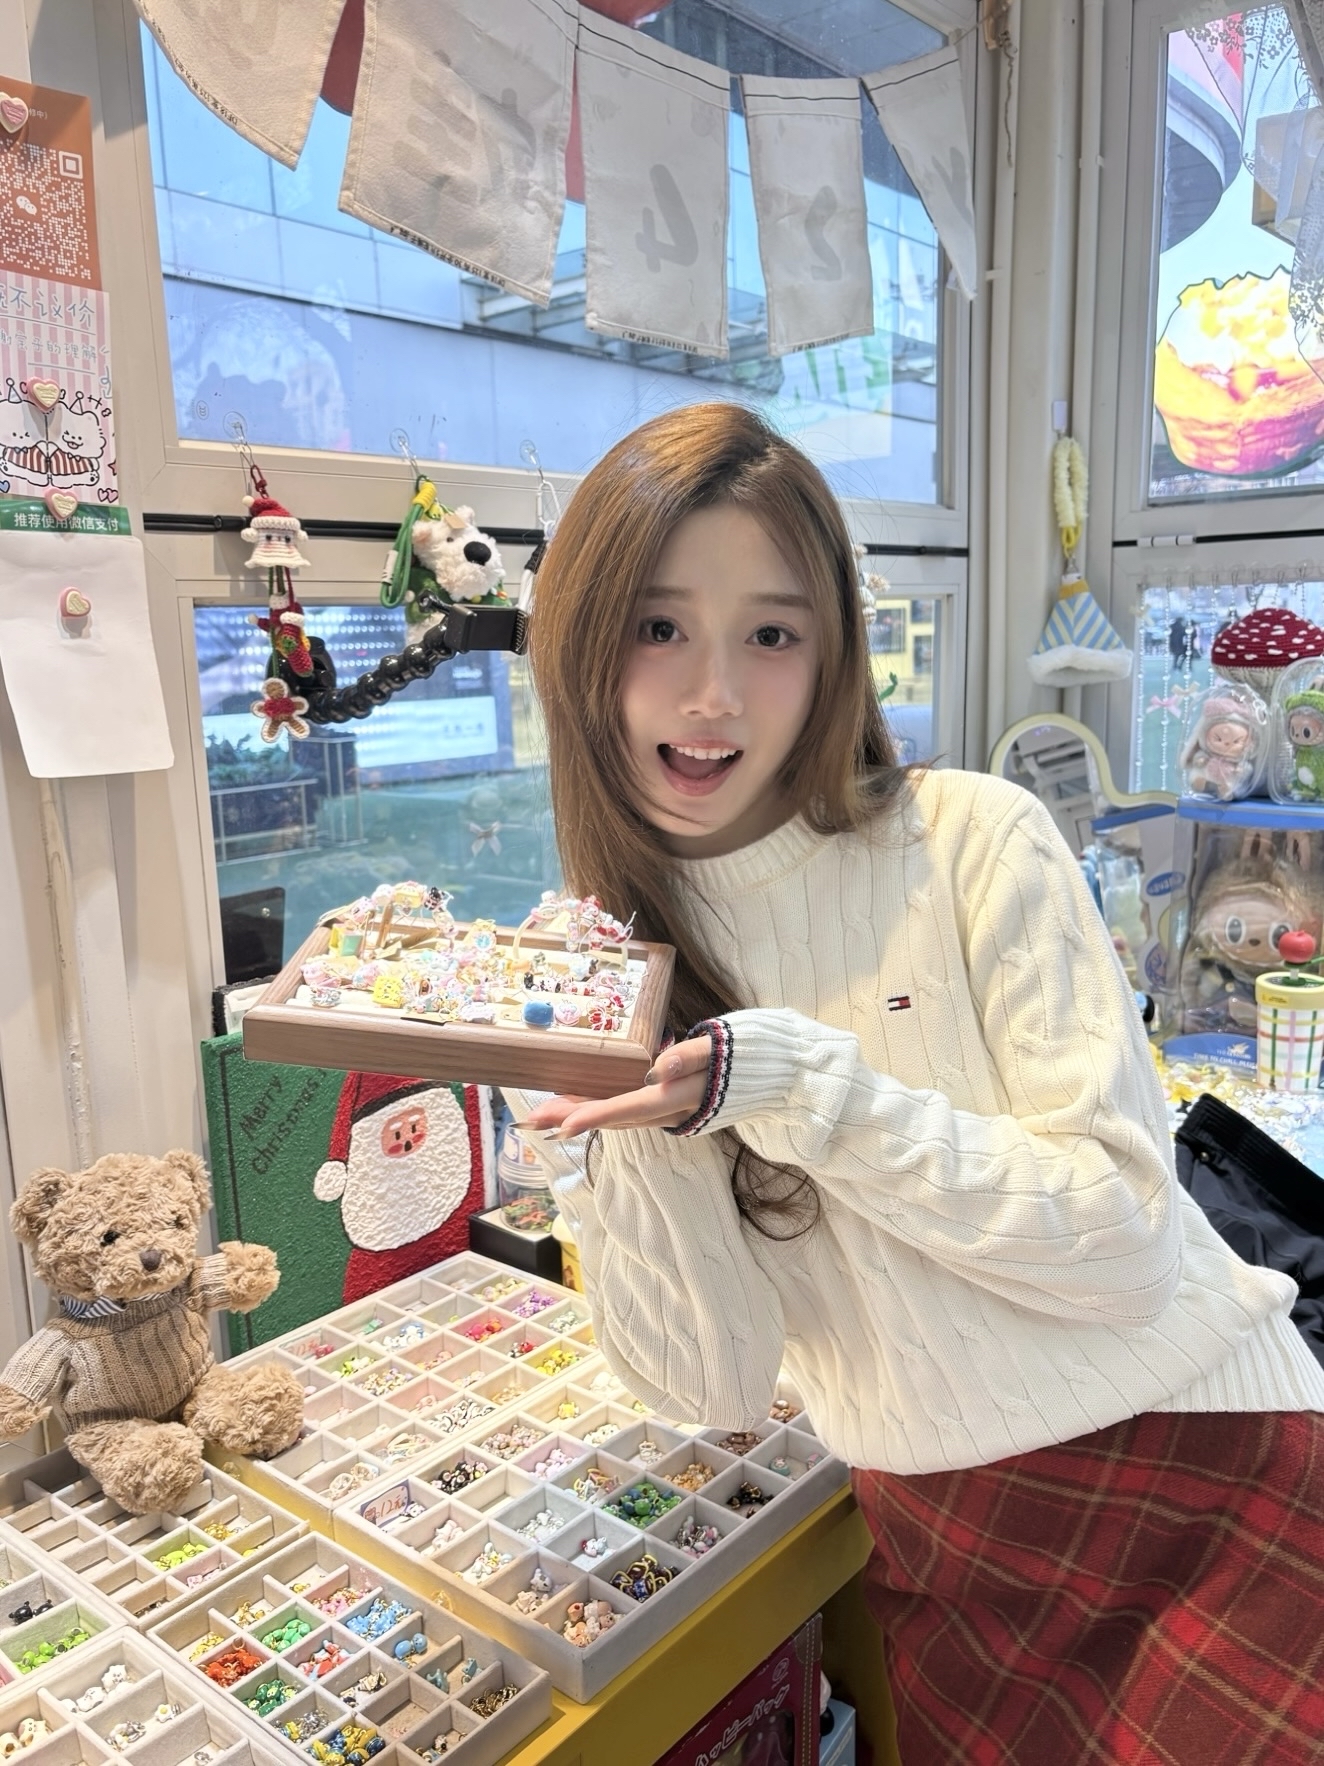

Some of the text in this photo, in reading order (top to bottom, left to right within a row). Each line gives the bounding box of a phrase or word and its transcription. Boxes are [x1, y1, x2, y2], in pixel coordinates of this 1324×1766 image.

[14, 512, 119, 531] 推荐使用微信支付
